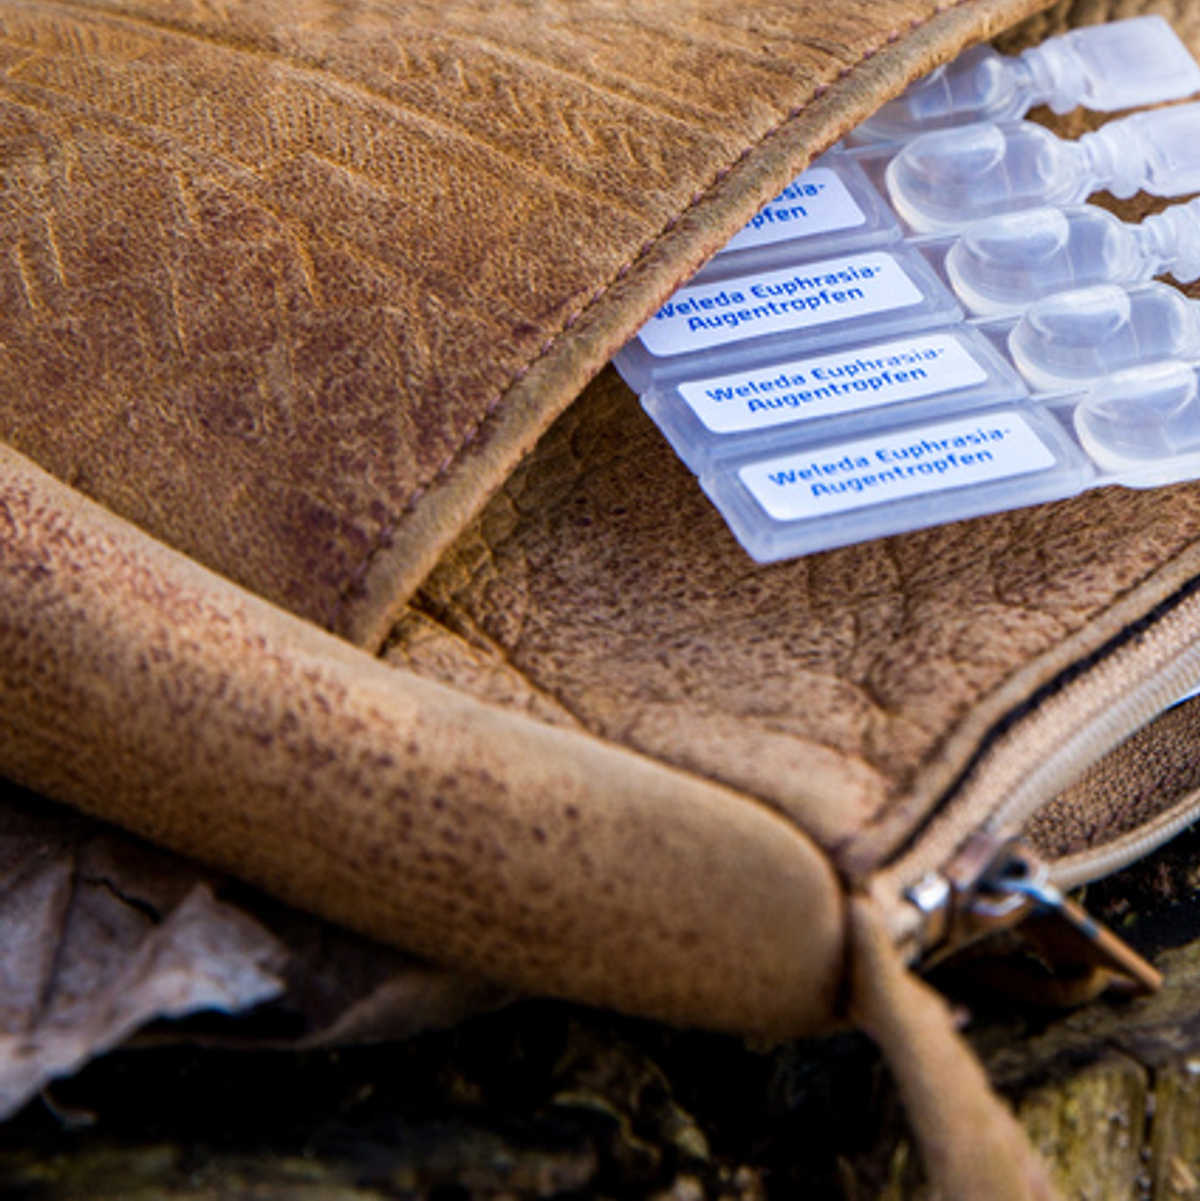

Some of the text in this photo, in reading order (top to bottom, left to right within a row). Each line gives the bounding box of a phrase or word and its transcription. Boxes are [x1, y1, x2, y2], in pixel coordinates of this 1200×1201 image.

[655, 265, 882, 320] Weleda Euphrasia-
[687, 286, 865, 332] Augentropfen
[705, 347, 945, 403] Weleda Euphrasia-
[747, 366, 928, 413] Augentropfen
[767, 428, 1011, 487] Weleda Euphrasia-
[810, 449, 994, 497] Augentropfen
